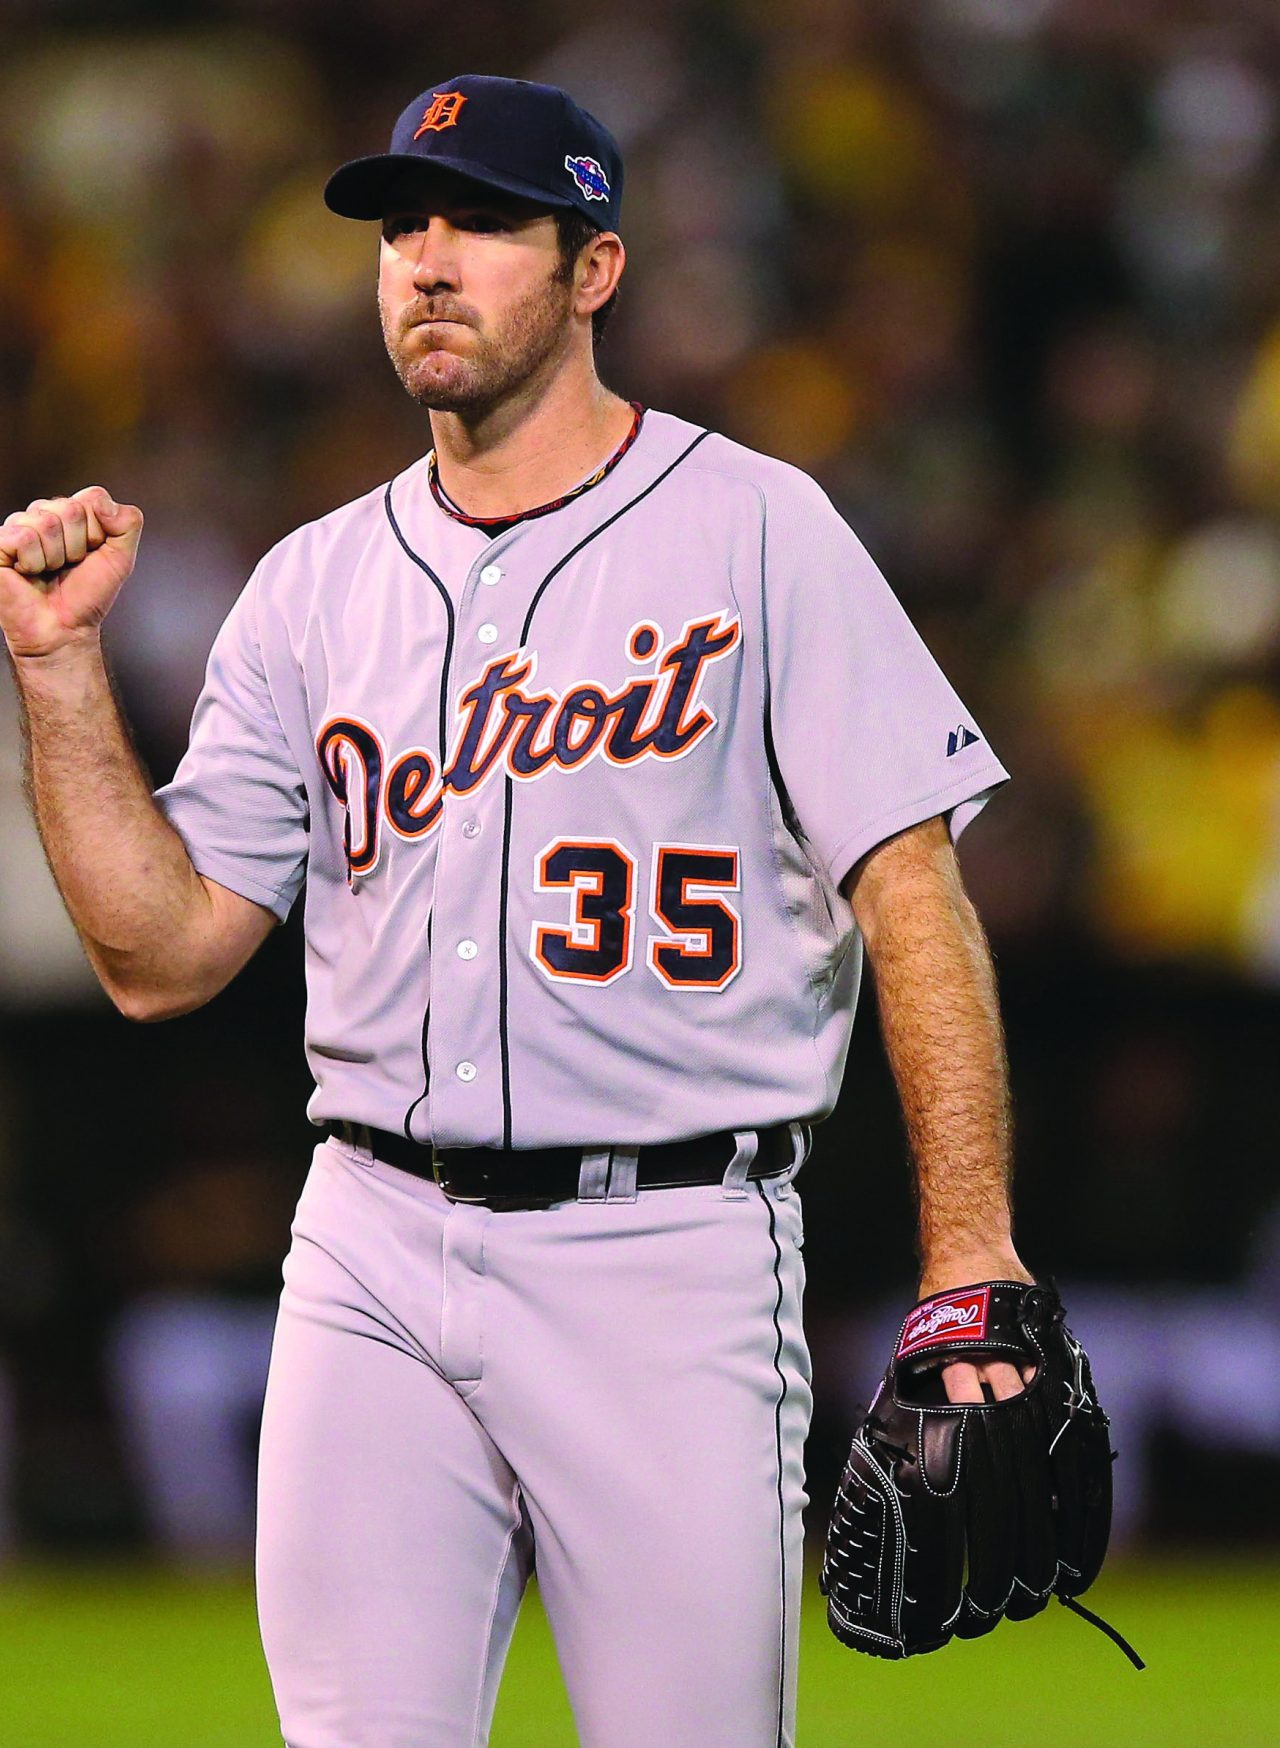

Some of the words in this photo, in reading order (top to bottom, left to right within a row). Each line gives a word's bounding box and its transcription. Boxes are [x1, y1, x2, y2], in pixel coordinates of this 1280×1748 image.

[413, 90, 468, 140] D
[316, 608, 743, 889] Detroit
[529, 836, 743, 993] 35
